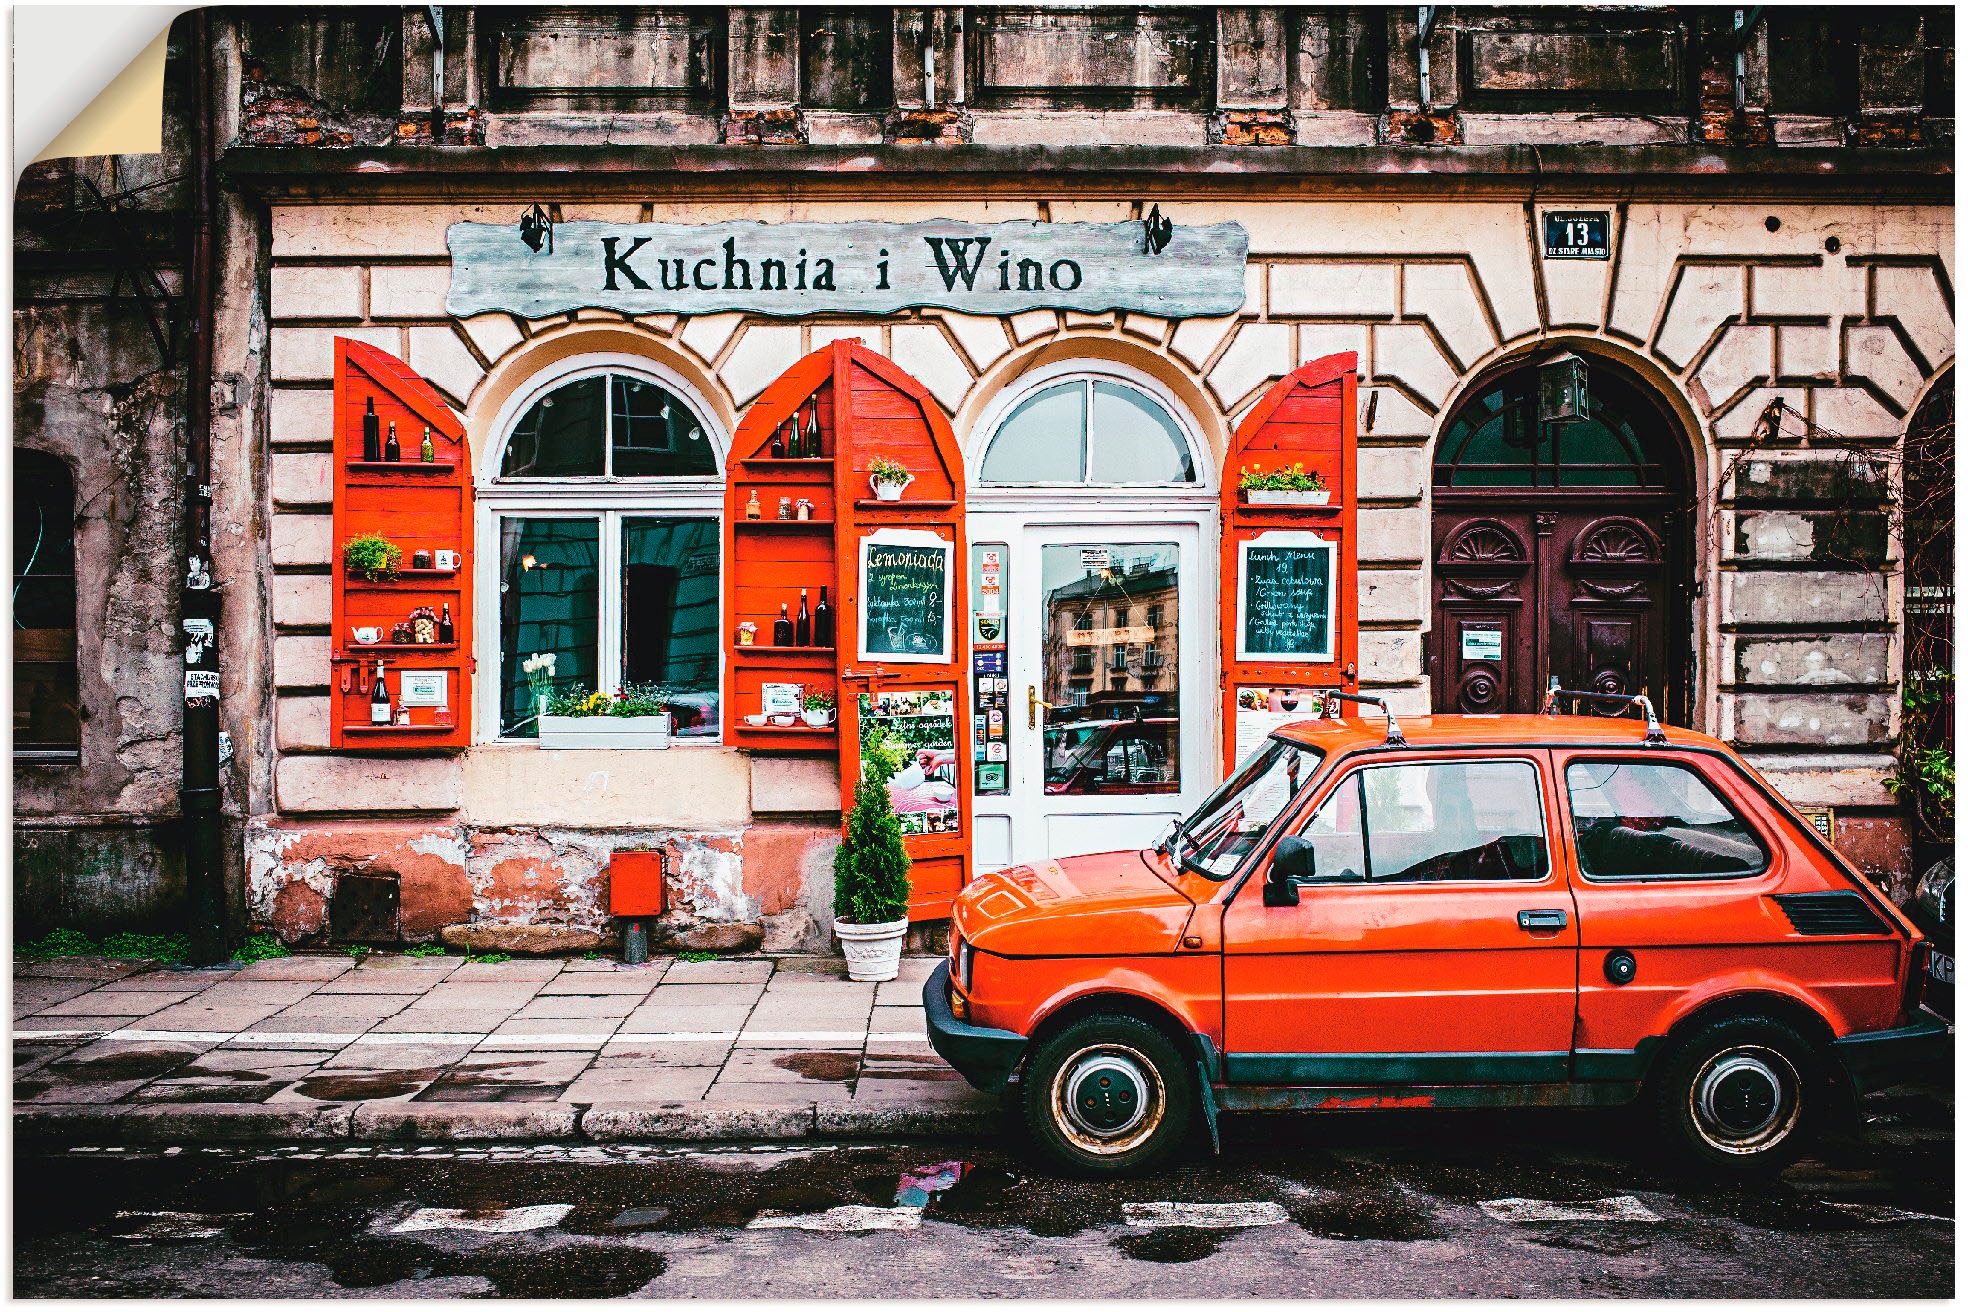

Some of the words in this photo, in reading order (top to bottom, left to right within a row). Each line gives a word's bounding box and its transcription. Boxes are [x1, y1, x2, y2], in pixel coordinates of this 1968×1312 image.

[1565, 222, 1589, 246] 13
[601, 236, 836, 292] Kuchnia
[877, 247, 890, 291] i
[925, 236, 1083, 293] Wino
[867, 546, 944, 572] Lemoniada
